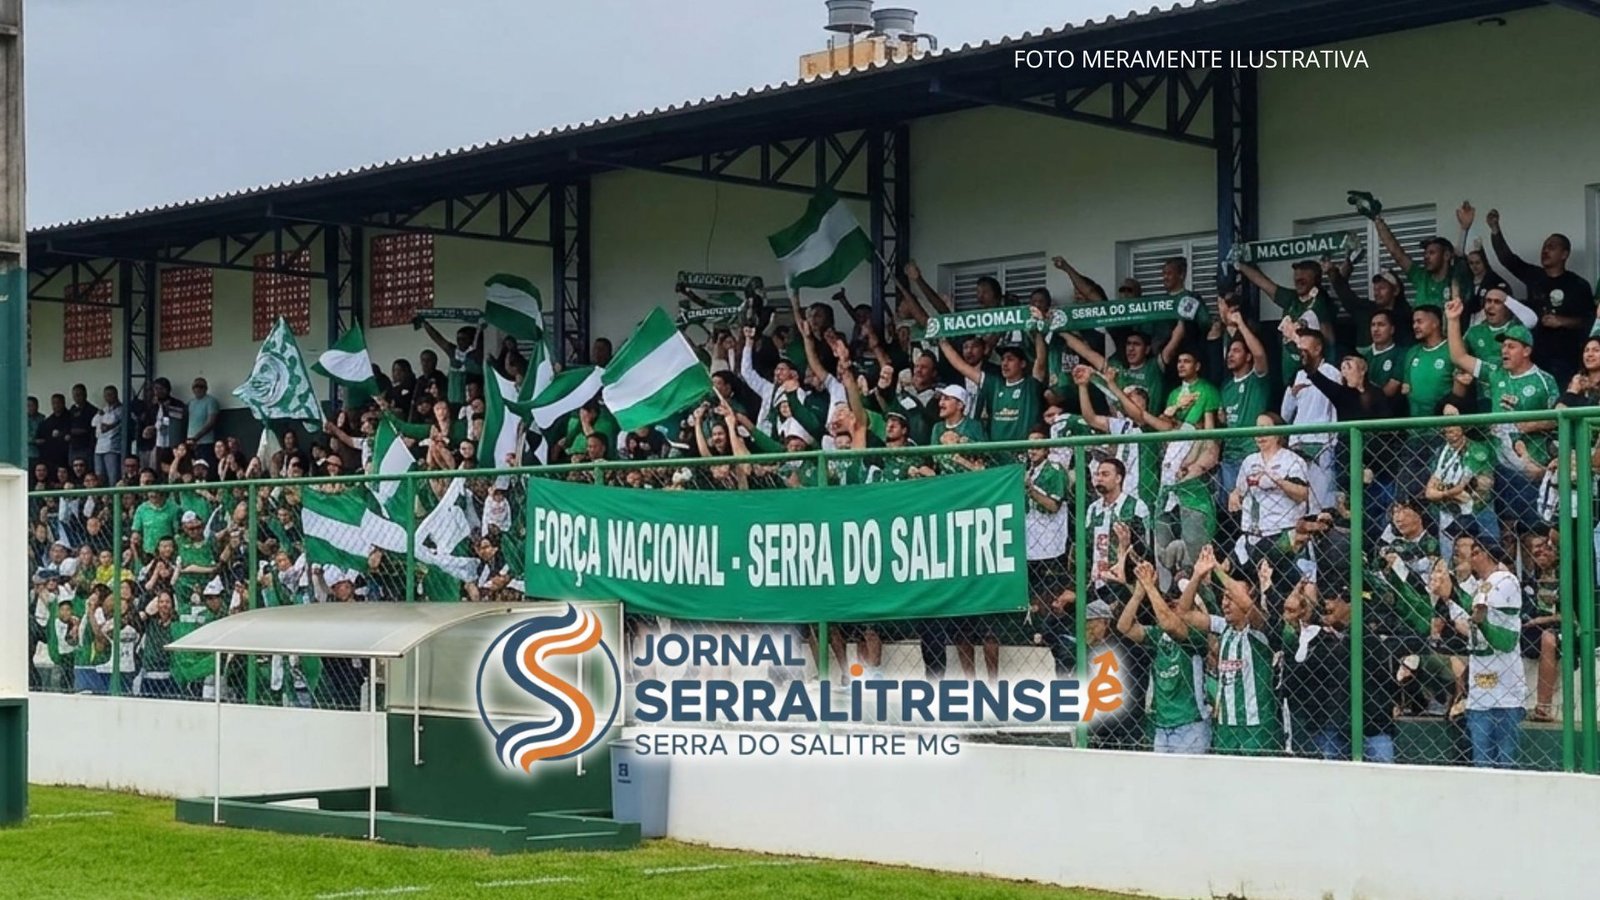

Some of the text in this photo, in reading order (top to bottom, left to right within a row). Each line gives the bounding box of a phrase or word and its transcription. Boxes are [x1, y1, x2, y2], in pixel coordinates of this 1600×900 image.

[1129, 299, 1175, 313] SALITRE
[534, 507, 601, 587] FORÇA
[607, 519, 725, 586] NACIONAL
[748, 522, 835, 587] SERRA
[843, 519, 882, 585] DO
[891, 503, 1015, 583] SALITRE
